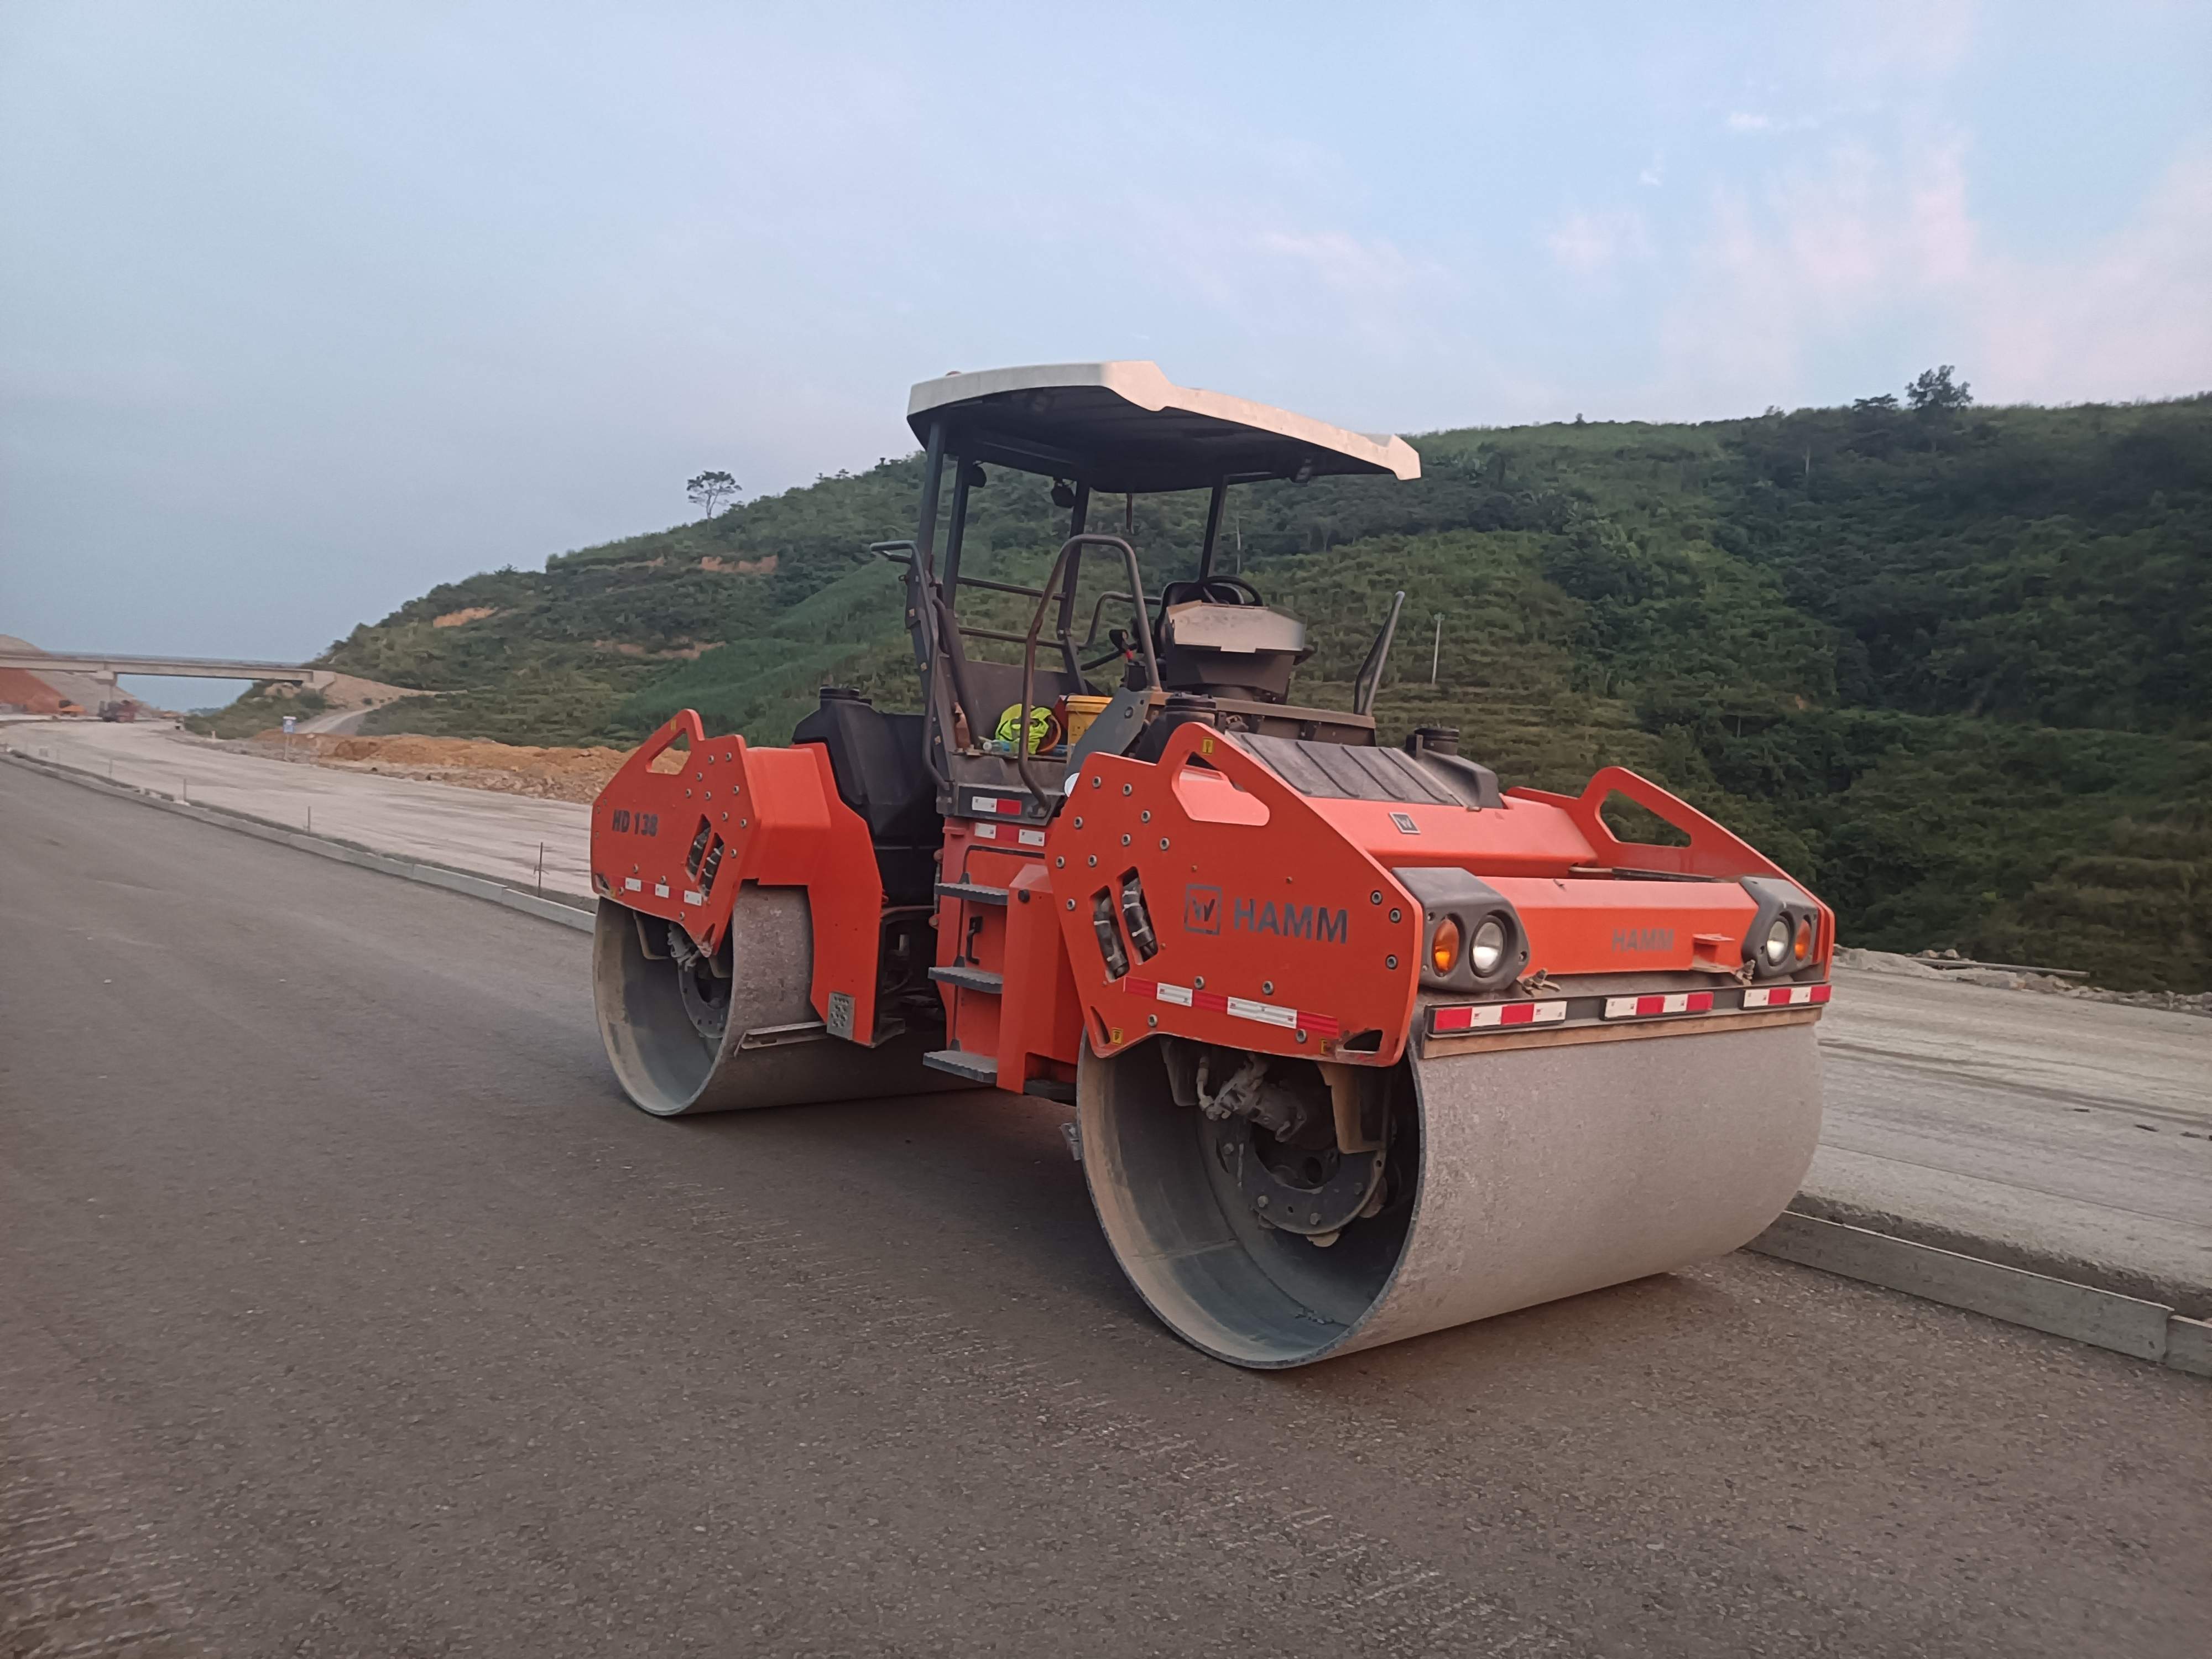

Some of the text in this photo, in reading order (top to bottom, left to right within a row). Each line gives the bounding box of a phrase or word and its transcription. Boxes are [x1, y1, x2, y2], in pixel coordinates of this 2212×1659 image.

[612, 809, 630, 832] HD
[1234, 897, 1348, 944] HAMM
[1611, 928, 1674, 952] HAMM
